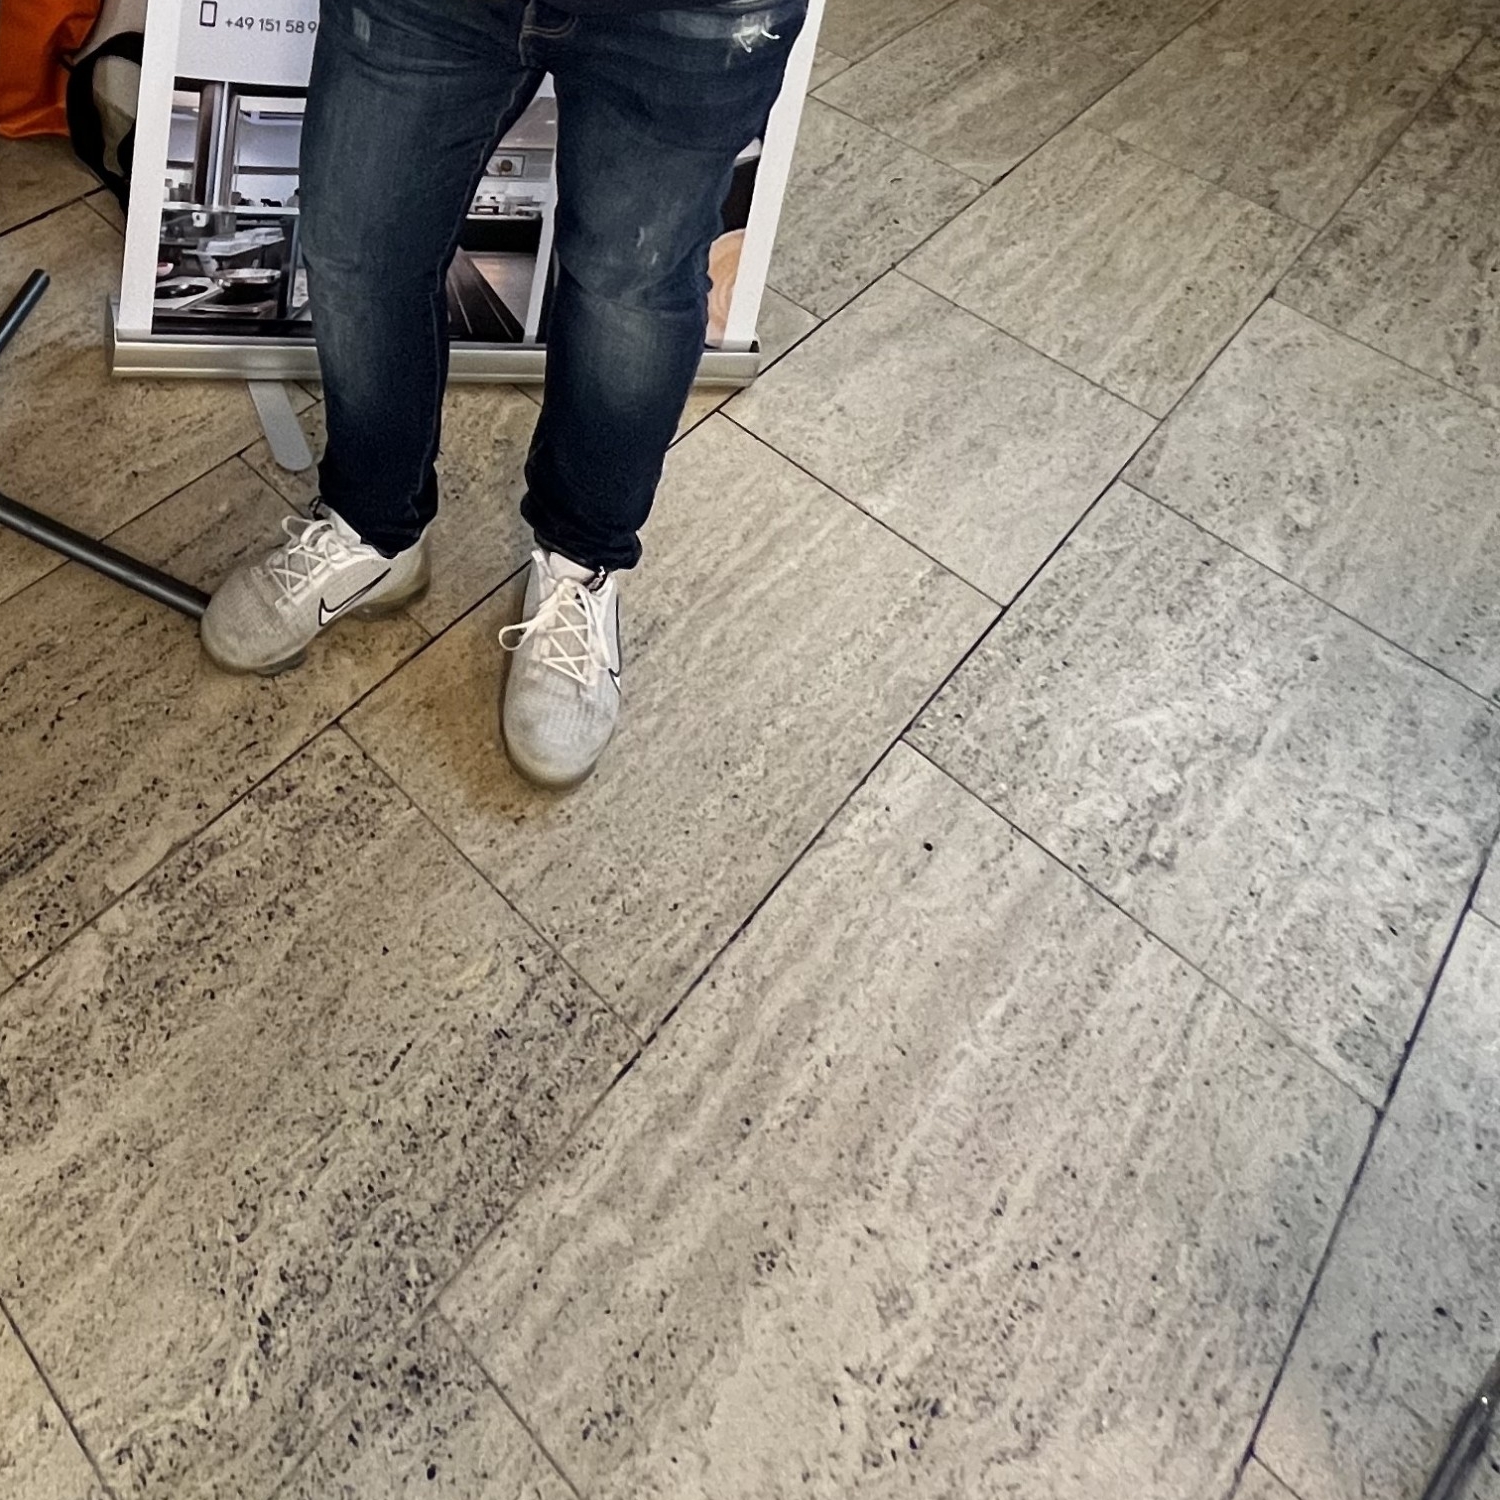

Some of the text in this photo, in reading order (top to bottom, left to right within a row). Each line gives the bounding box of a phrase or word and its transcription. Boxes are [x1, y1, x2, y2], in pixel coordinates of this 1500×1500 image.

[224, 15, 255, 31] +49
[258, 17, 281, 33] 151
[307, 20, 318, 34] 9
